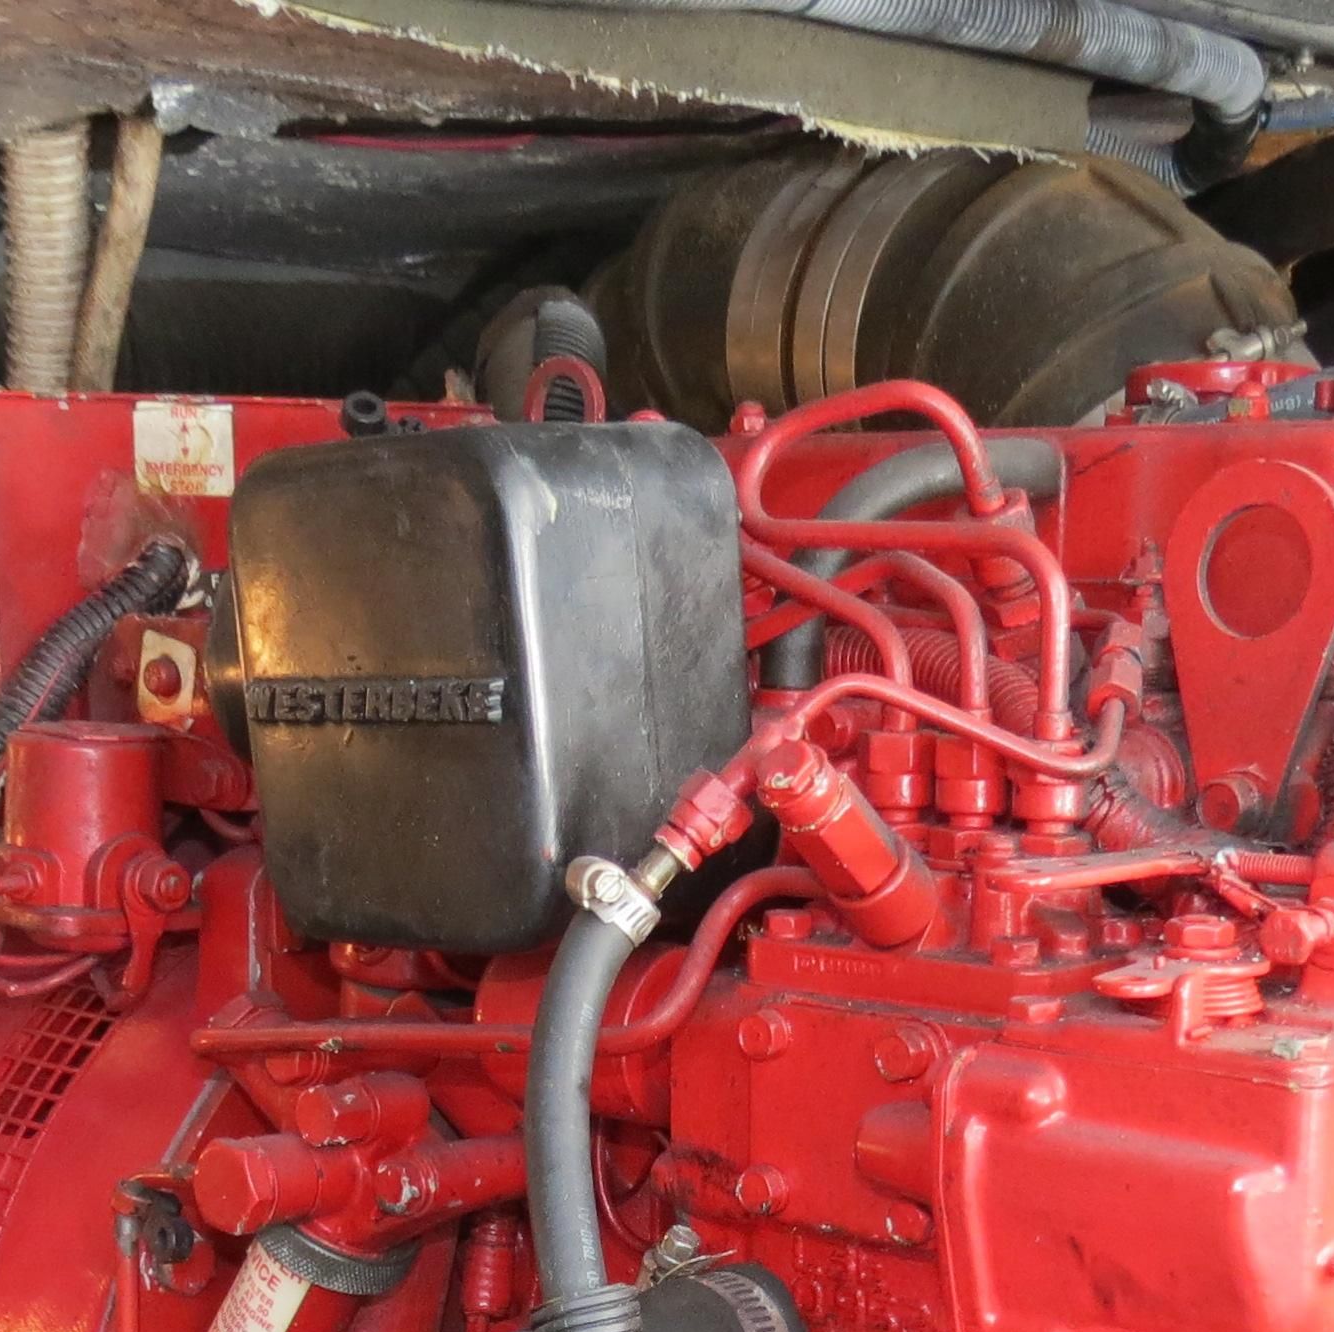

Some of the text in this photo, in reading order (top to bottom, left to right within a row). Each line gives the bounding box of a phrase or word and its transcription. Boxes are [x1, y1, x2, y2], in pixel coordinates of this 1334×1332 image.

[170, 405, 198, 419] RUN
[145, 462, 225, 476] EMERGENCY
[246, 678, 505, 722] WESTERBEKE
